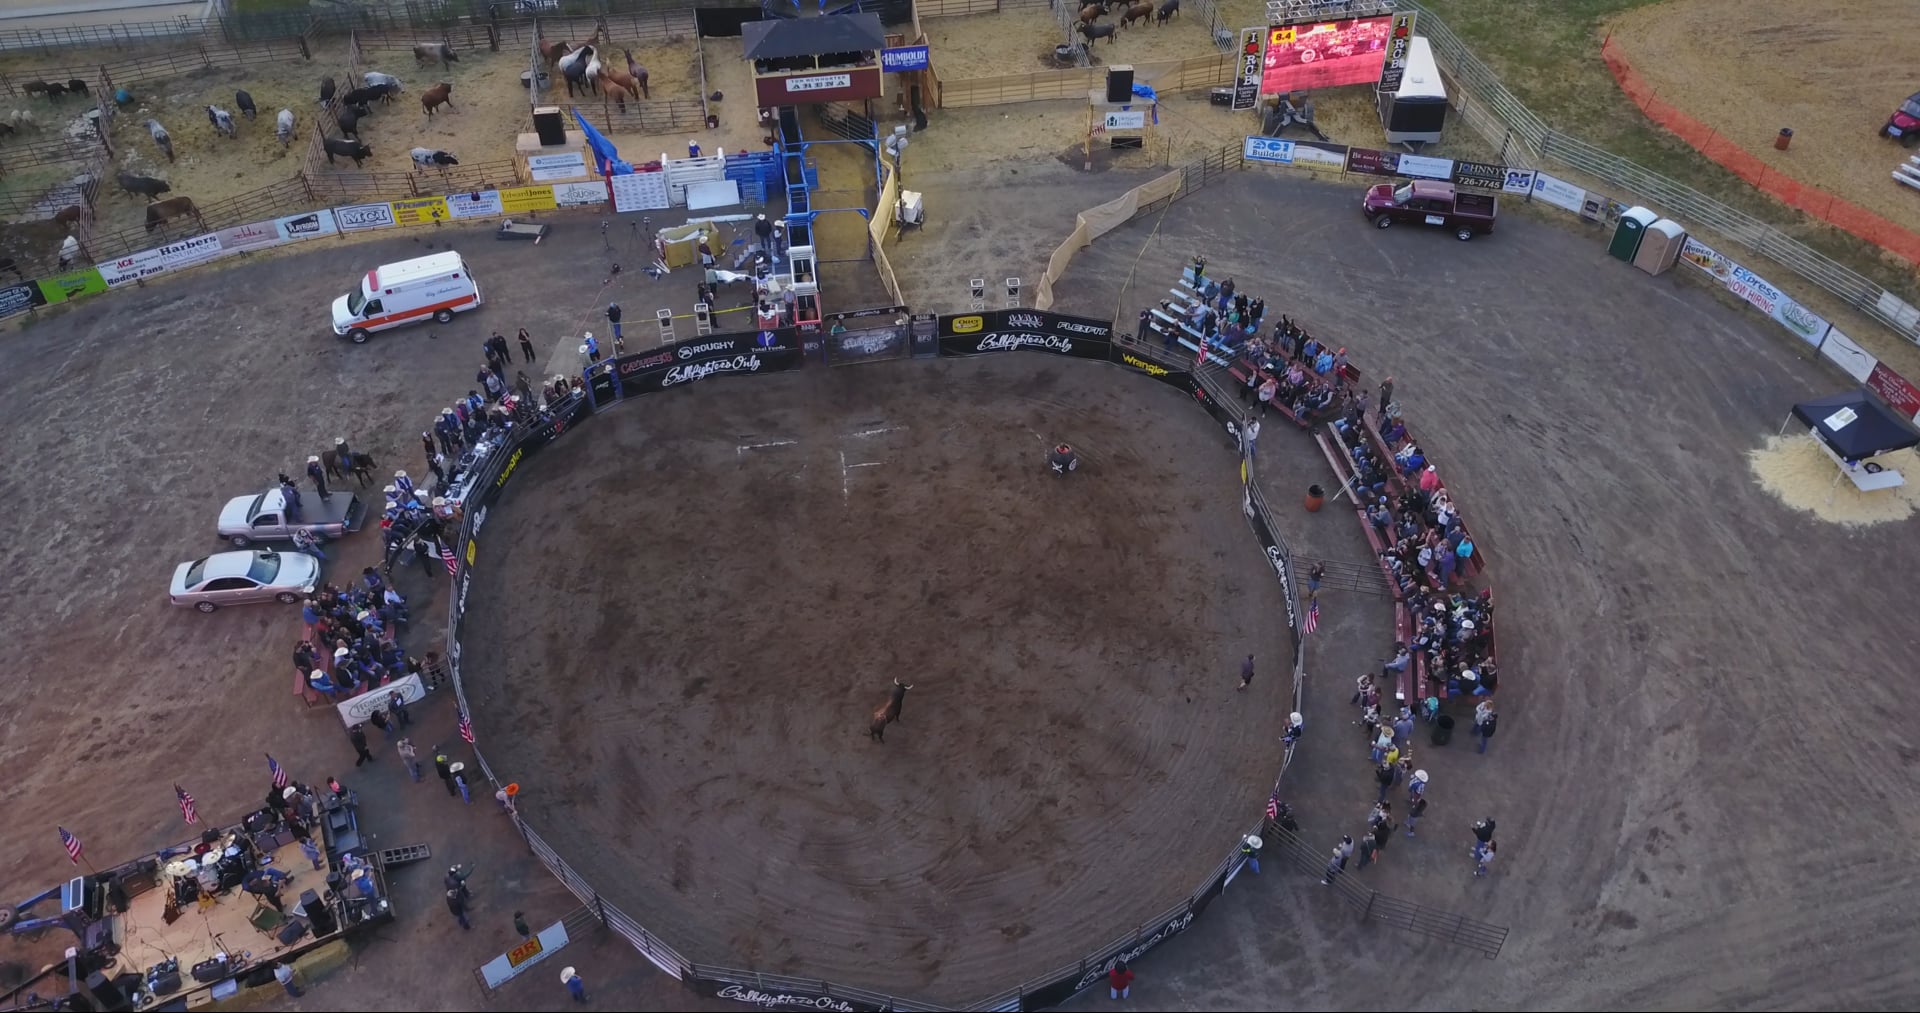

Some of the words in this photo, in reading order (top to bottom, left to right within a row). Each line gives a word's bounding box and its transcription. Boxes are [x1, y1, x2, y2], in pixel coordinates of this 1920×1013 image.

[1275, 32, 1292, 41] 8.4
[884, 51, 927, 66] HUMBOLDT
[792, 80, 846, 90] ARENA
[1252, 150, 1288, 160] Builders
[1457, 162, 1508, 179] JOHNNY'S
[1458, 177, 1500, 189] 726-7745
[344, 210, 388, 225] MCI
[288, 221, 318, 233] PLAYROOM
[159, 235, 217, 256] Harbers
[116, 258, 135, 269] ACE
[107, 271, 138, 286] Rodeo
[140, 265, 164, 276] Fans
[1726, 278, 1747, 296] NOW
[1747, 290, 1776, 314] HIRING
[1057, 321, 1108, 336] FLEXFIT
[693, 341, 735, 355] ROUGHY
[1045, 335, 1073, 353] Only
[732, 354, 761, 371] Only
[1122, 353, 1169, 376] Wrangler
